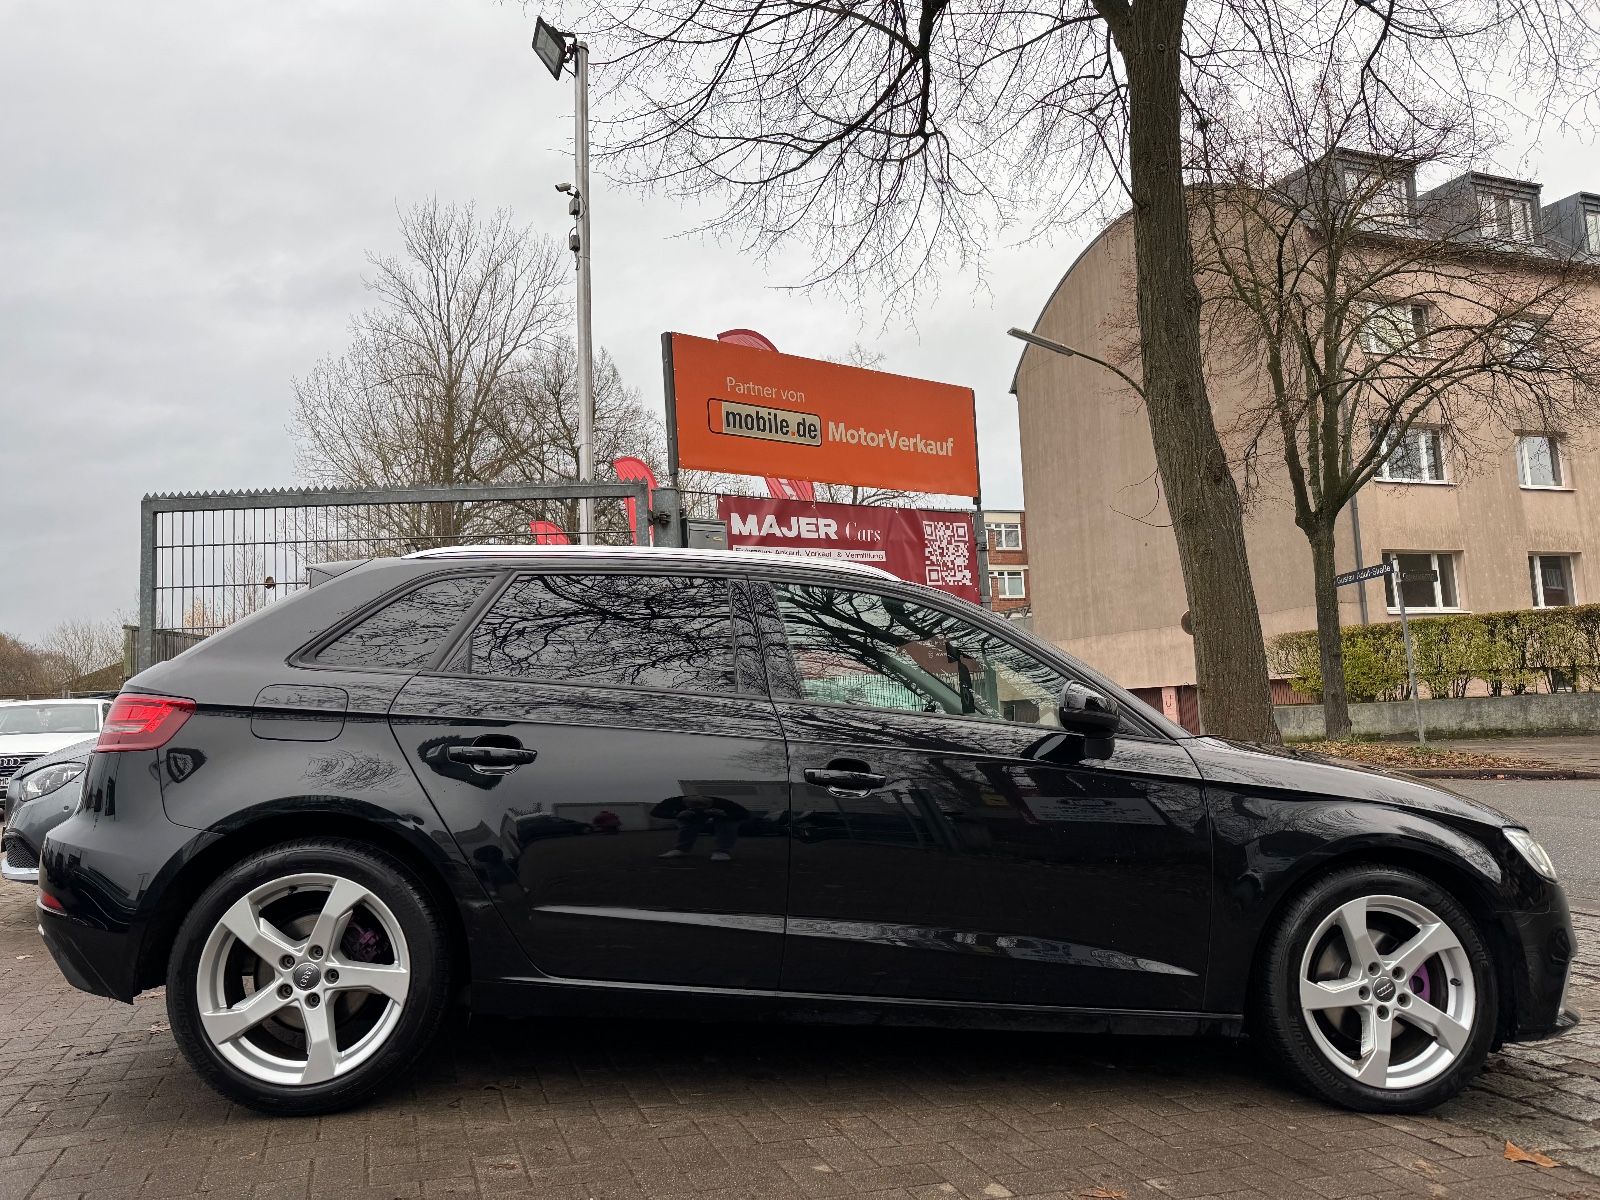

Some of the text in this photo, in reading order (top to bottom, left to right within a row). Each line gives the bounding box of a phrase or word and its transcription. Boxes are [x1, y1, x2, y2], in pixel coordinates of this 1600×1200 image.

[726, 376, 805, 404] Partner von
[725, 410, 954, 456] mobile.de MotorVerkauf
[730, 512, 881, 542] MAJER Cars
[844, 551, 884, 561] Vermittlung
